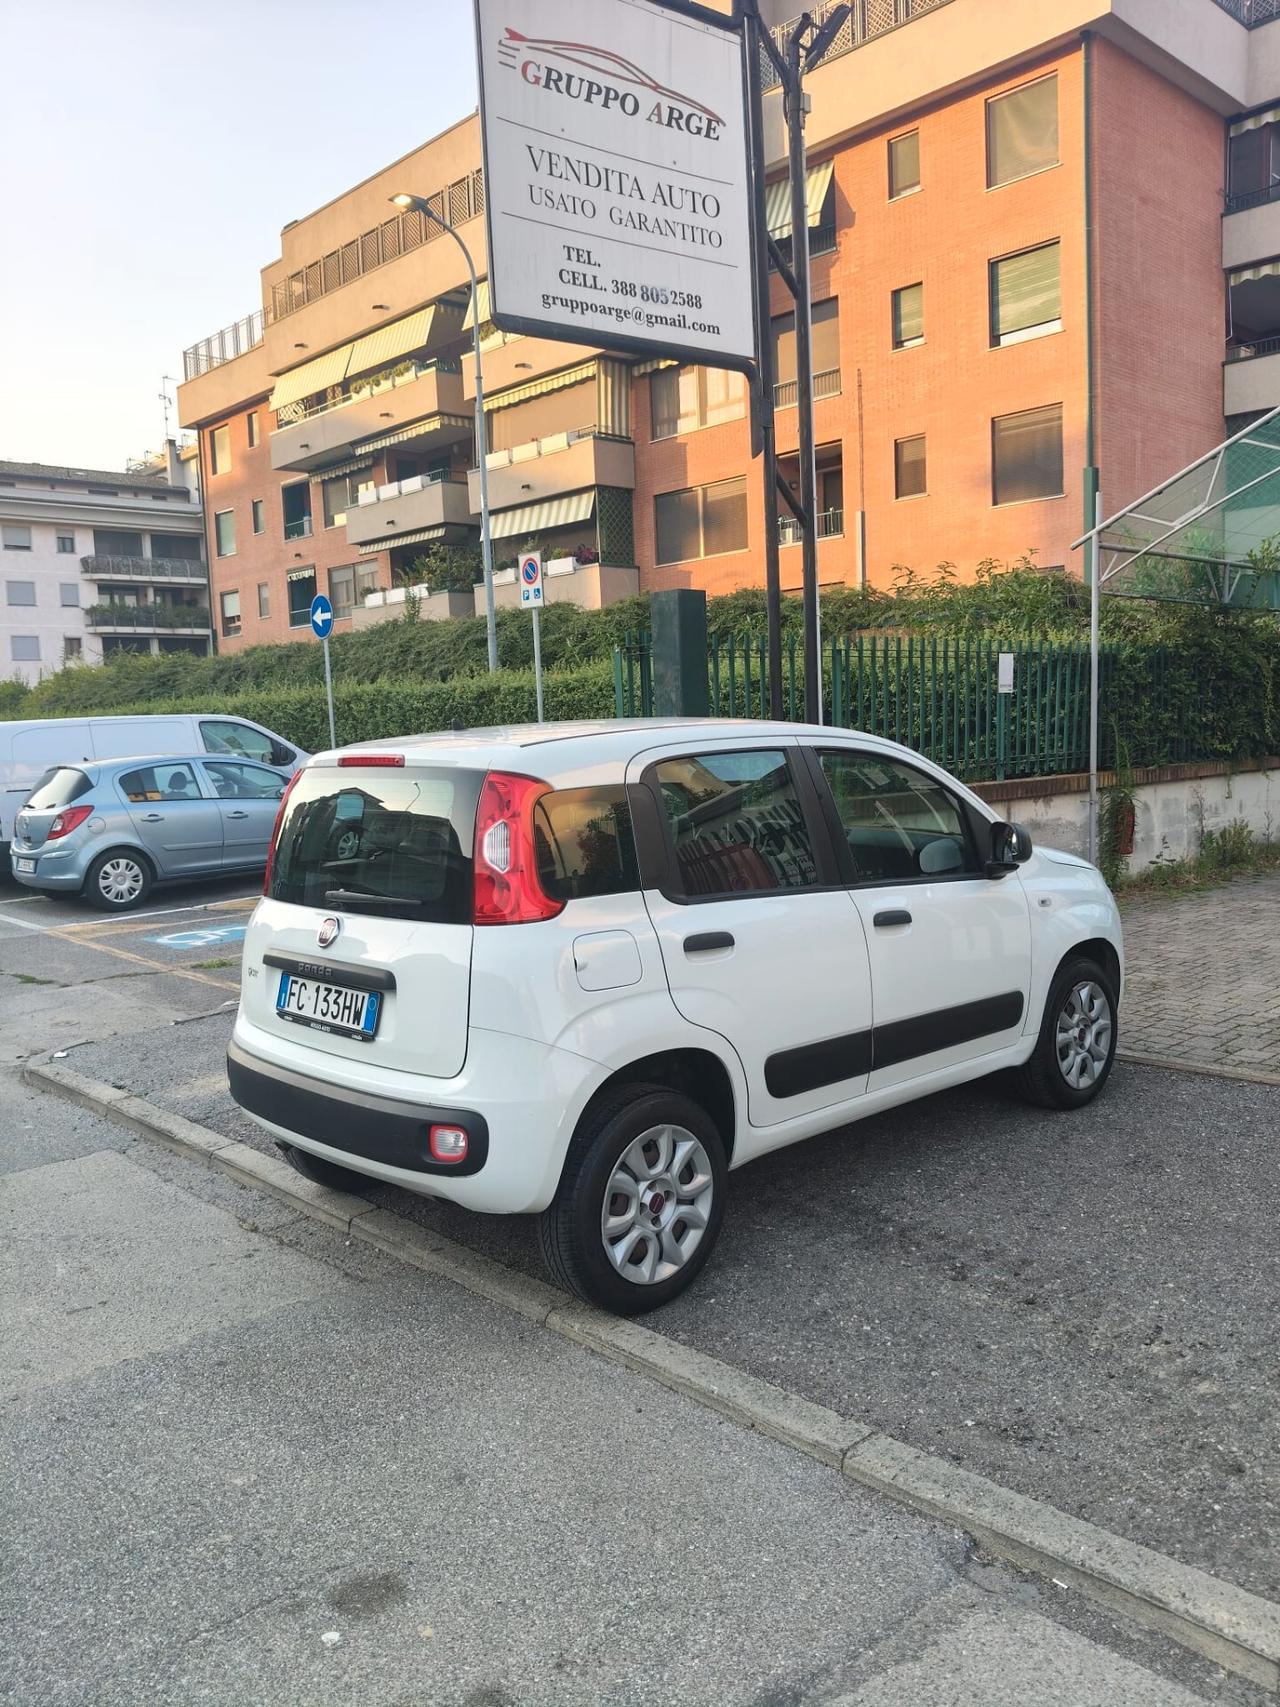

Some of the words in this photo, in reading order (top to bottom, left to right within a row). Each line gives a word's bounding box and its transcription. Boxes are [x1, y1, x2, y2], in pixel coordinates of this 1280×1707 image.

[521, 60, 640, 117] GRUPPO
[646, 102, 721, 141] ARGE
[526, 144, 647, 201] VENDITA
[652, 181, 721, 218] AUTO
[528, 184, 597, 219] USATO
[609, 206, 723, 249] GARANTITO
[559, 268, 608, 292] CELL.
[563, 245, 601, 267] TEL.
[541, 293, 721, 335] gruppoarge@gmail.com
